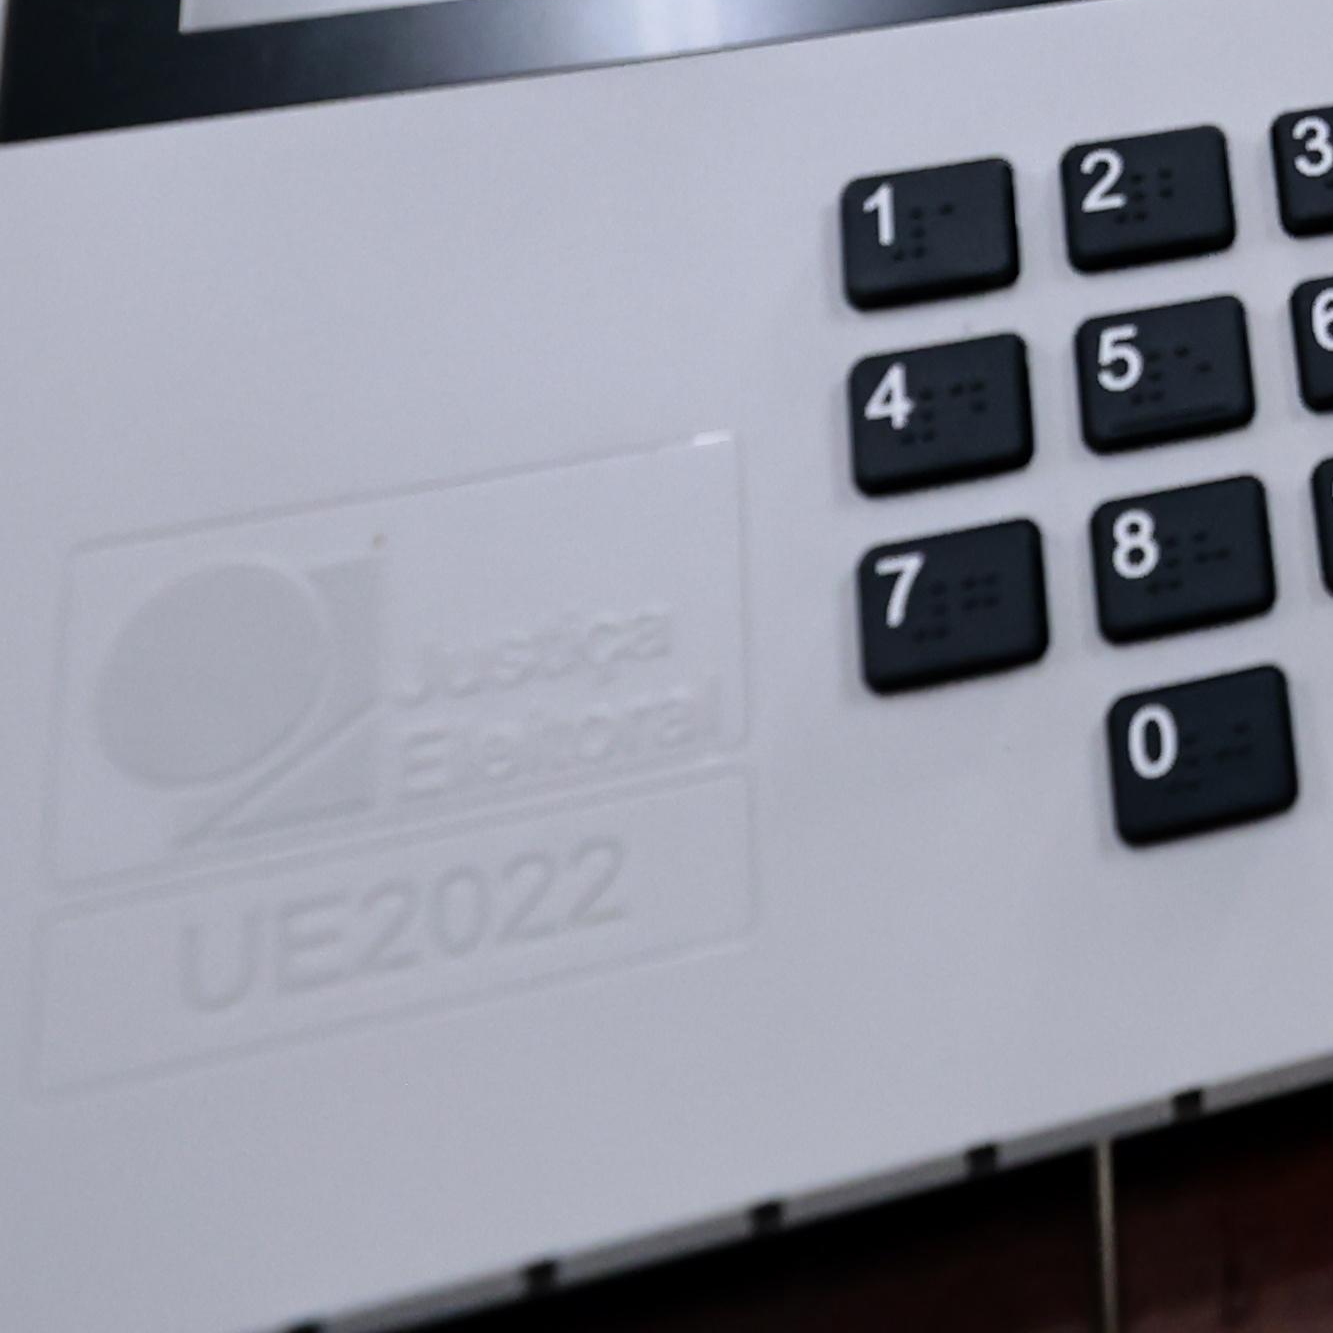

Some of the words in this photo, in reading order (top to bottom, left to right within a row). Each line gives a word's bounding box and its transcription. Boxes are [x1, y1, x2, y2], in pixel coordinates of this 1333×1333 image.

[1080, 151, 1126, 213] 2
[863, 187, 897, 247] 1
[1096, 326, 1143, 391] 5
[864, 365, 913, 429] 4
[1112, 511, 1160, 580] 8
[874, 553, 925, 627] 7
[1127, 703, 1178, 779] 0
[178, 838, 627, 1013] UE2022
